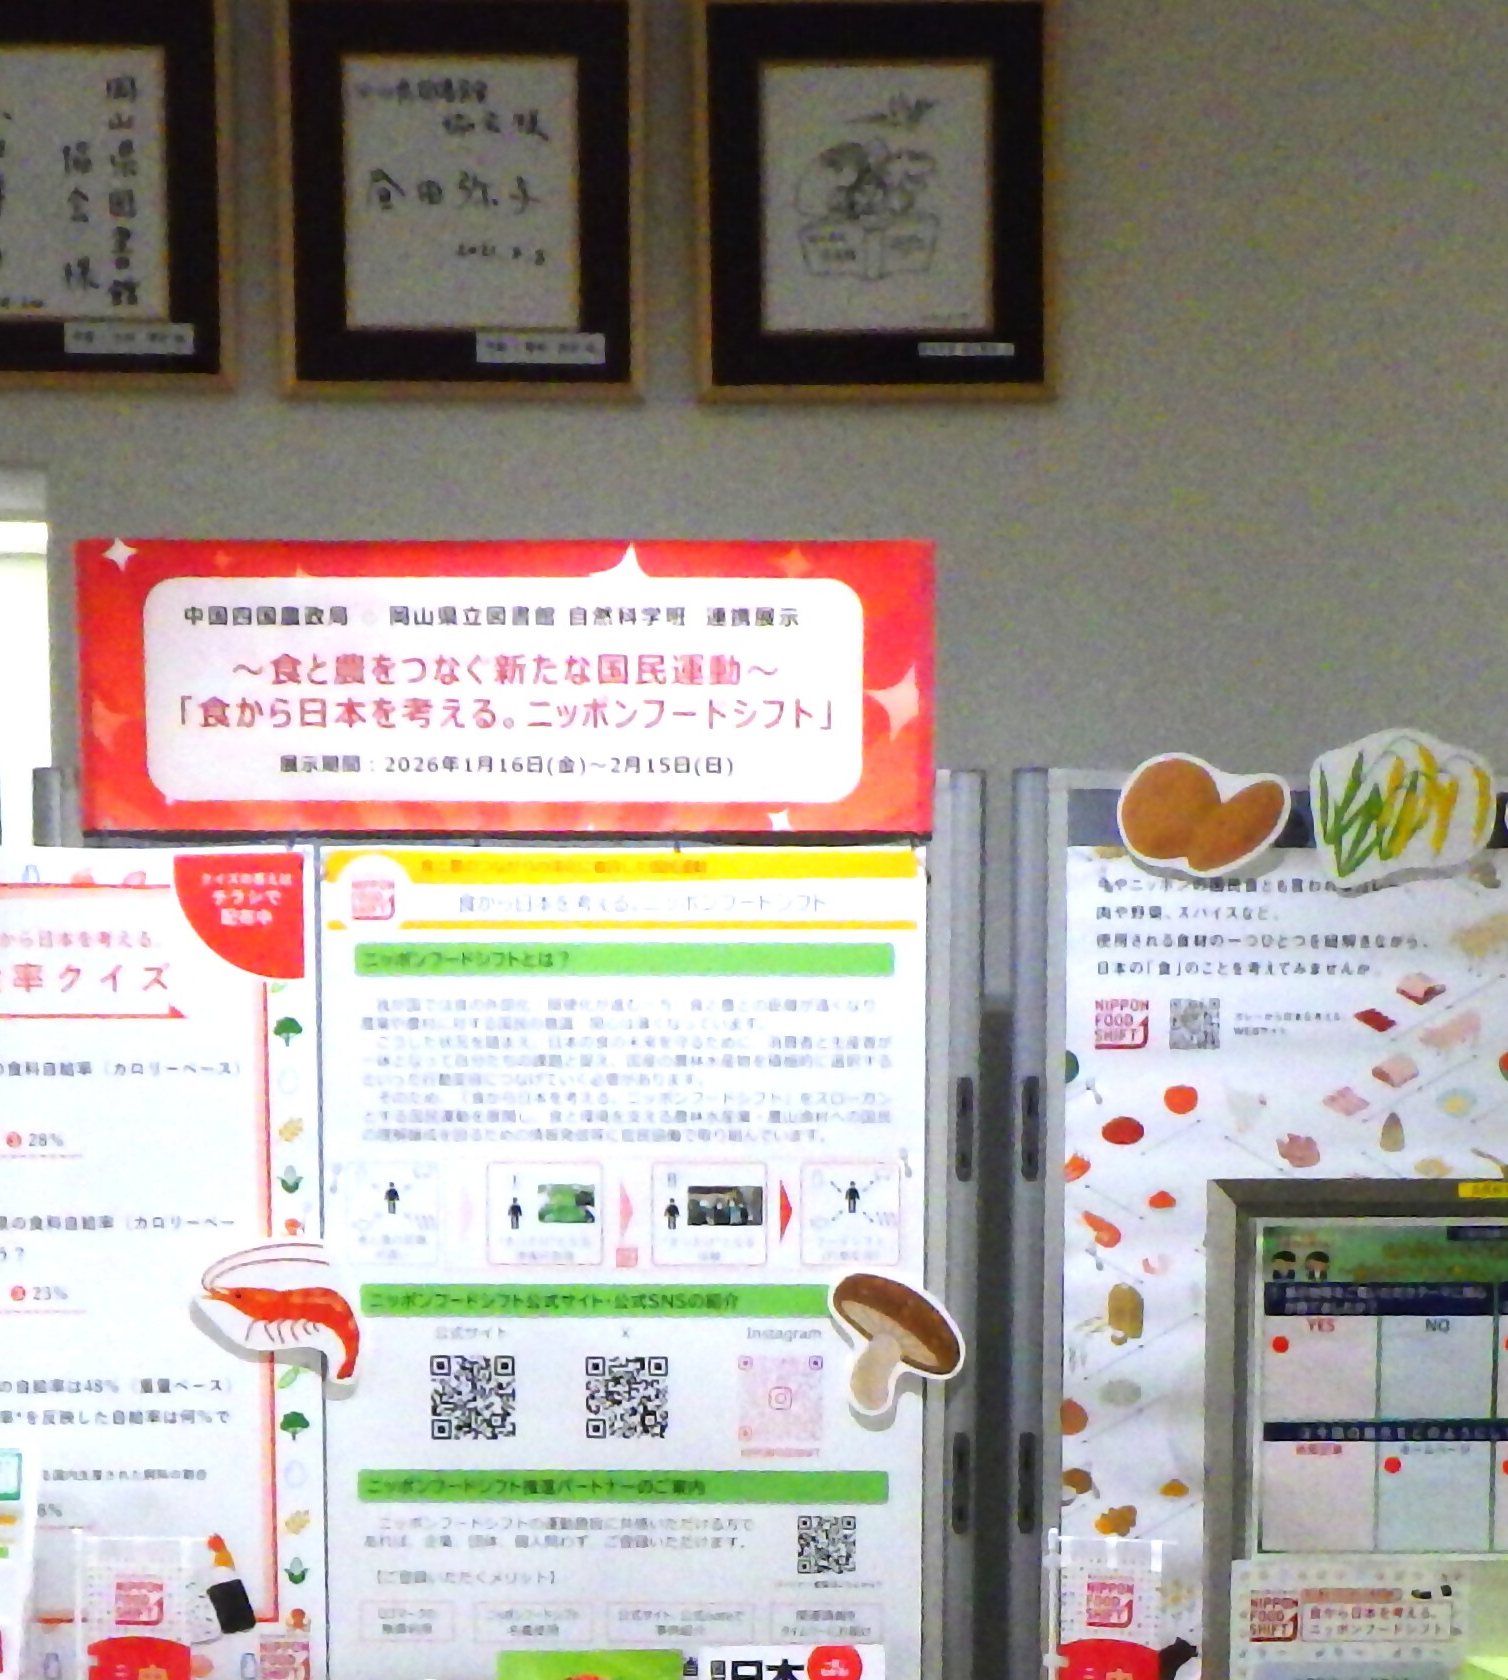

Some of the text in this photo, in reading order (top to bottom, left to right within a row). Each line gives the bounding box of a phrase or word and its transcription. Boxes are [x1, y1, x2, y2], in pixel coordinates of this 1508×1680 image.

[185, 606, 348, 626] 中国四国農政局
[389, 606, 555, 626] 岡山県立図書館
[180, 695, 833, 731] 「食から日本を考える。ニッポンフードシフト」
[1094, 999, 1150, 1012] NIPPON
[1094, 1013, 1135, 1027] FOOD
[1094, 1028, 1137, 1042] SHIFT
[1306, 1317, 1336, 1333] YES
[1425, 1317, 1451, 1333] NO
[746, 1326, 823, 1343] Instagram
[1249, 1609, 1286, 1622] FOOD
[1249, 1623, 1289, 1636] SHIFT
